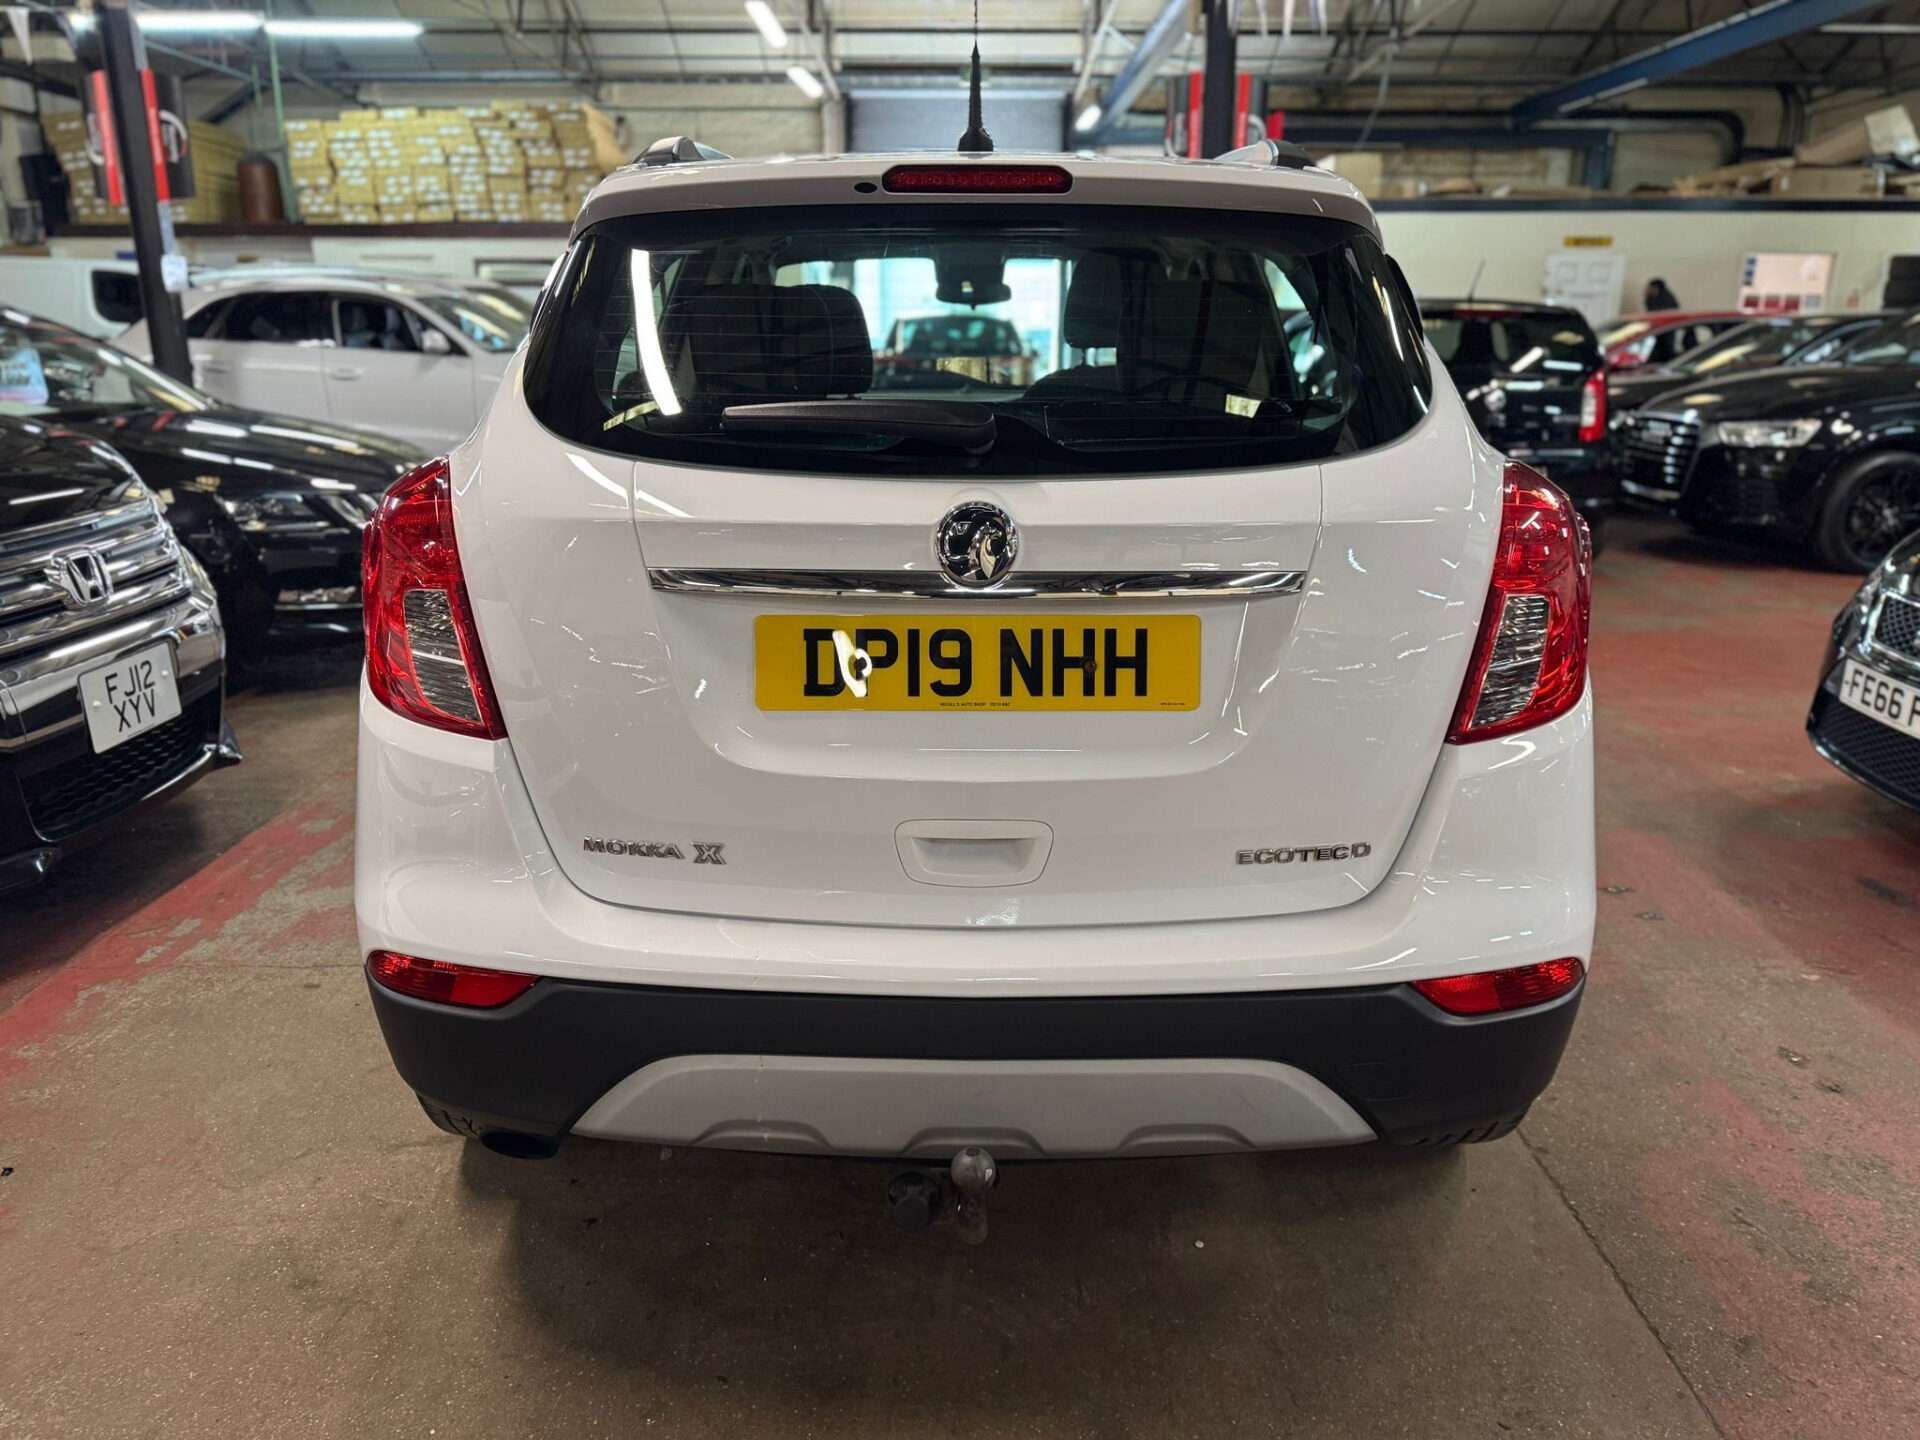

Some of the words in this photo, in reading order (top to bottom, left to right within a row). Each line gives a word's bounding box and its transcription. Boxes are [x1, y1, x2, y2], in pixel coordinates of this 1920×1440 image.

[105, 660, 155, 704] FJ12
[803, 628, 972, 697] DP19
[1000, 628, 1148, 697] NHH
[114, 688, 155, 732] XYV
[1848, 668, 1905, 720] FE66
[583, 835, 685, 860] MOKKA
[691, 840, 727, 865] X
